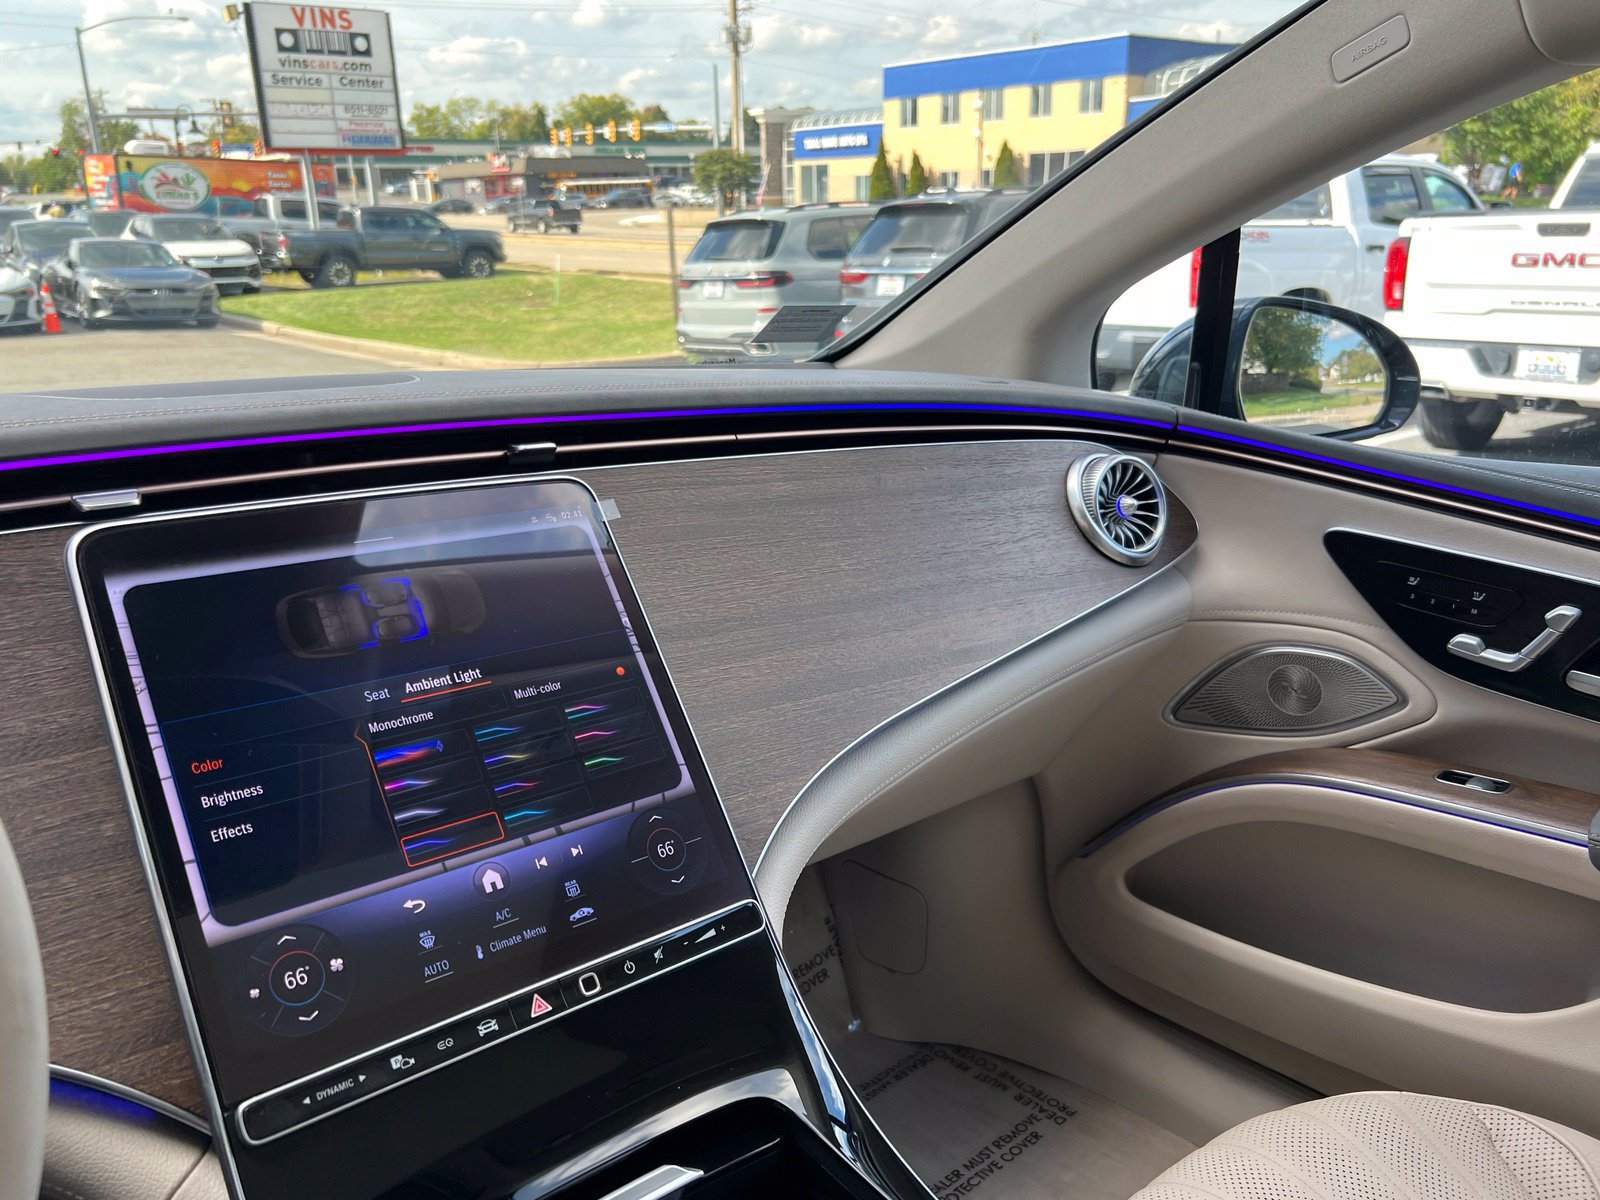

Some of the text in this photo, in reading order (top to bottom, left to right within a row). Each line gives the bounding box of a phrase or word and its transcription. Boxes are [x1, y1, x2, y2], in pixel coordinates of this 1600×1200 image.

[290, 6, 353, 30] VINS
[1352, 36, 1387, 63] AIRBAG
[278, 56, 372, 72] vinscars.com
[271, 73, 384, 89] Service Center
[1511, 253, 1600, 268] GMC
[364, 668, 483, 702] Seat Ambient Light
[514, 680, 562, 700] Multi-color
[368, 711, 434, 734] Monochrome
[191, 759, 223, 774] Color
[200, 785, 264, 809] Brightness
[210, 823, 253, 843] Effects
[495, 907, 512, 922] A/C
[419, 929, 431, 938] MAX
[489, 924, 547, 953] Climate Menu
[424, 959, 450, 978] AUTO
[437, 1037, 454, 1051] EQ
[316, 1078, 355, 1101] DYNAMIC
[973, 1071, 1010, 1093] MUST
[1000, 1068, 1078, 1118] PROTECTIVE
[962, 1145, 996, 1172] MUST
[992, 1112, 1043, 1150] REMOVE
[1000, 1130, 1044, 1162] COVER
